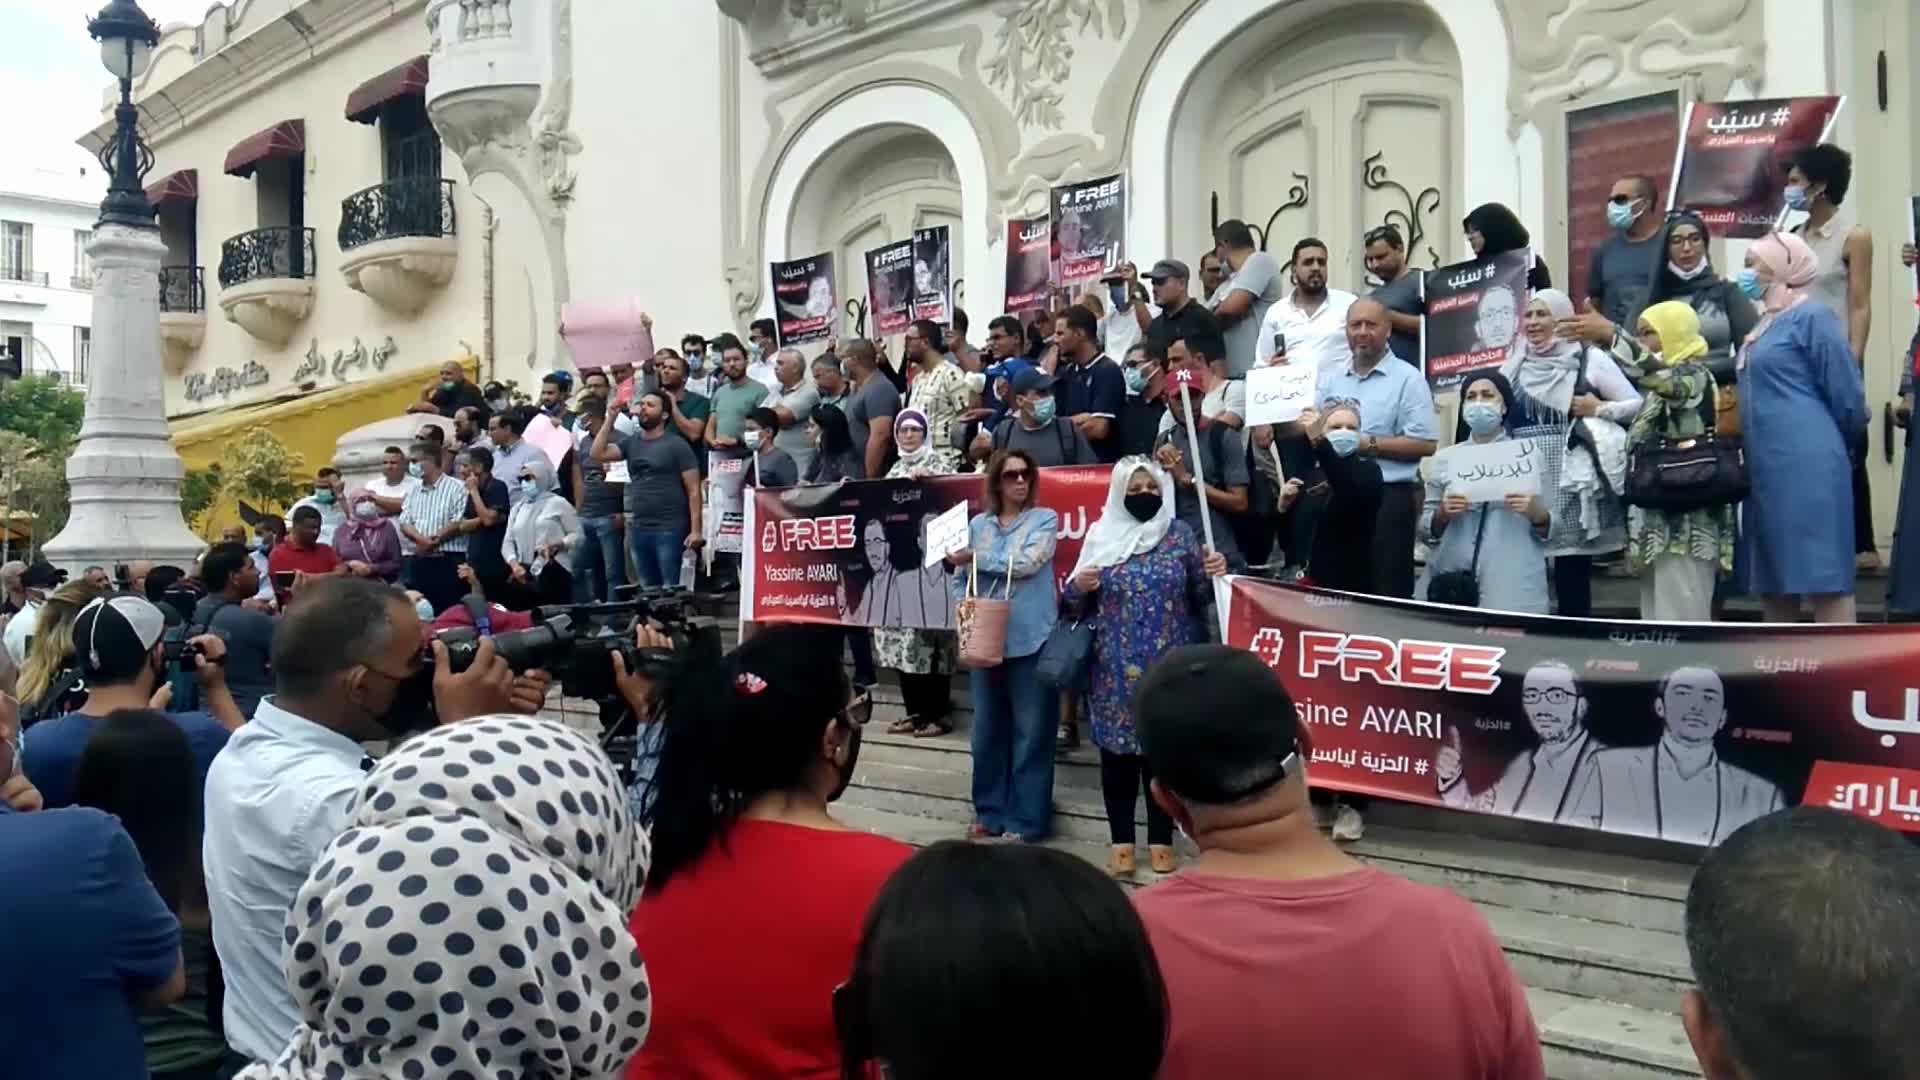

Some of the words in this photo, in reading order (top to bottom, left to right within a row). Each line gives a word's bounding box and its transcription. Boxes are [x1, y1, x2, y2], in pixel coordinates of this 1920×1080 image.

[1770, 106, 1791, 127] #
[1075, 181, 1120, 203] FREE
[881, 245, 911, 265] FREE
[1485, 263, 1496, 279] #
[762, 520, 777, 553] #
[780, 514, 857, 552] FREE
[764, 563, 804, 582] Yassine
[807, 562, 838, 582] AYARI
[1251, 628, 1283, 667] #
[1299, 631, 1506, 694] FREE
[1295, 697, 1348, 727] sine
[1360, 705, 1442, 739] AYARI
[1311, 747, 1357, 768] لياسي
[1415, 759, 1429, 775] #
